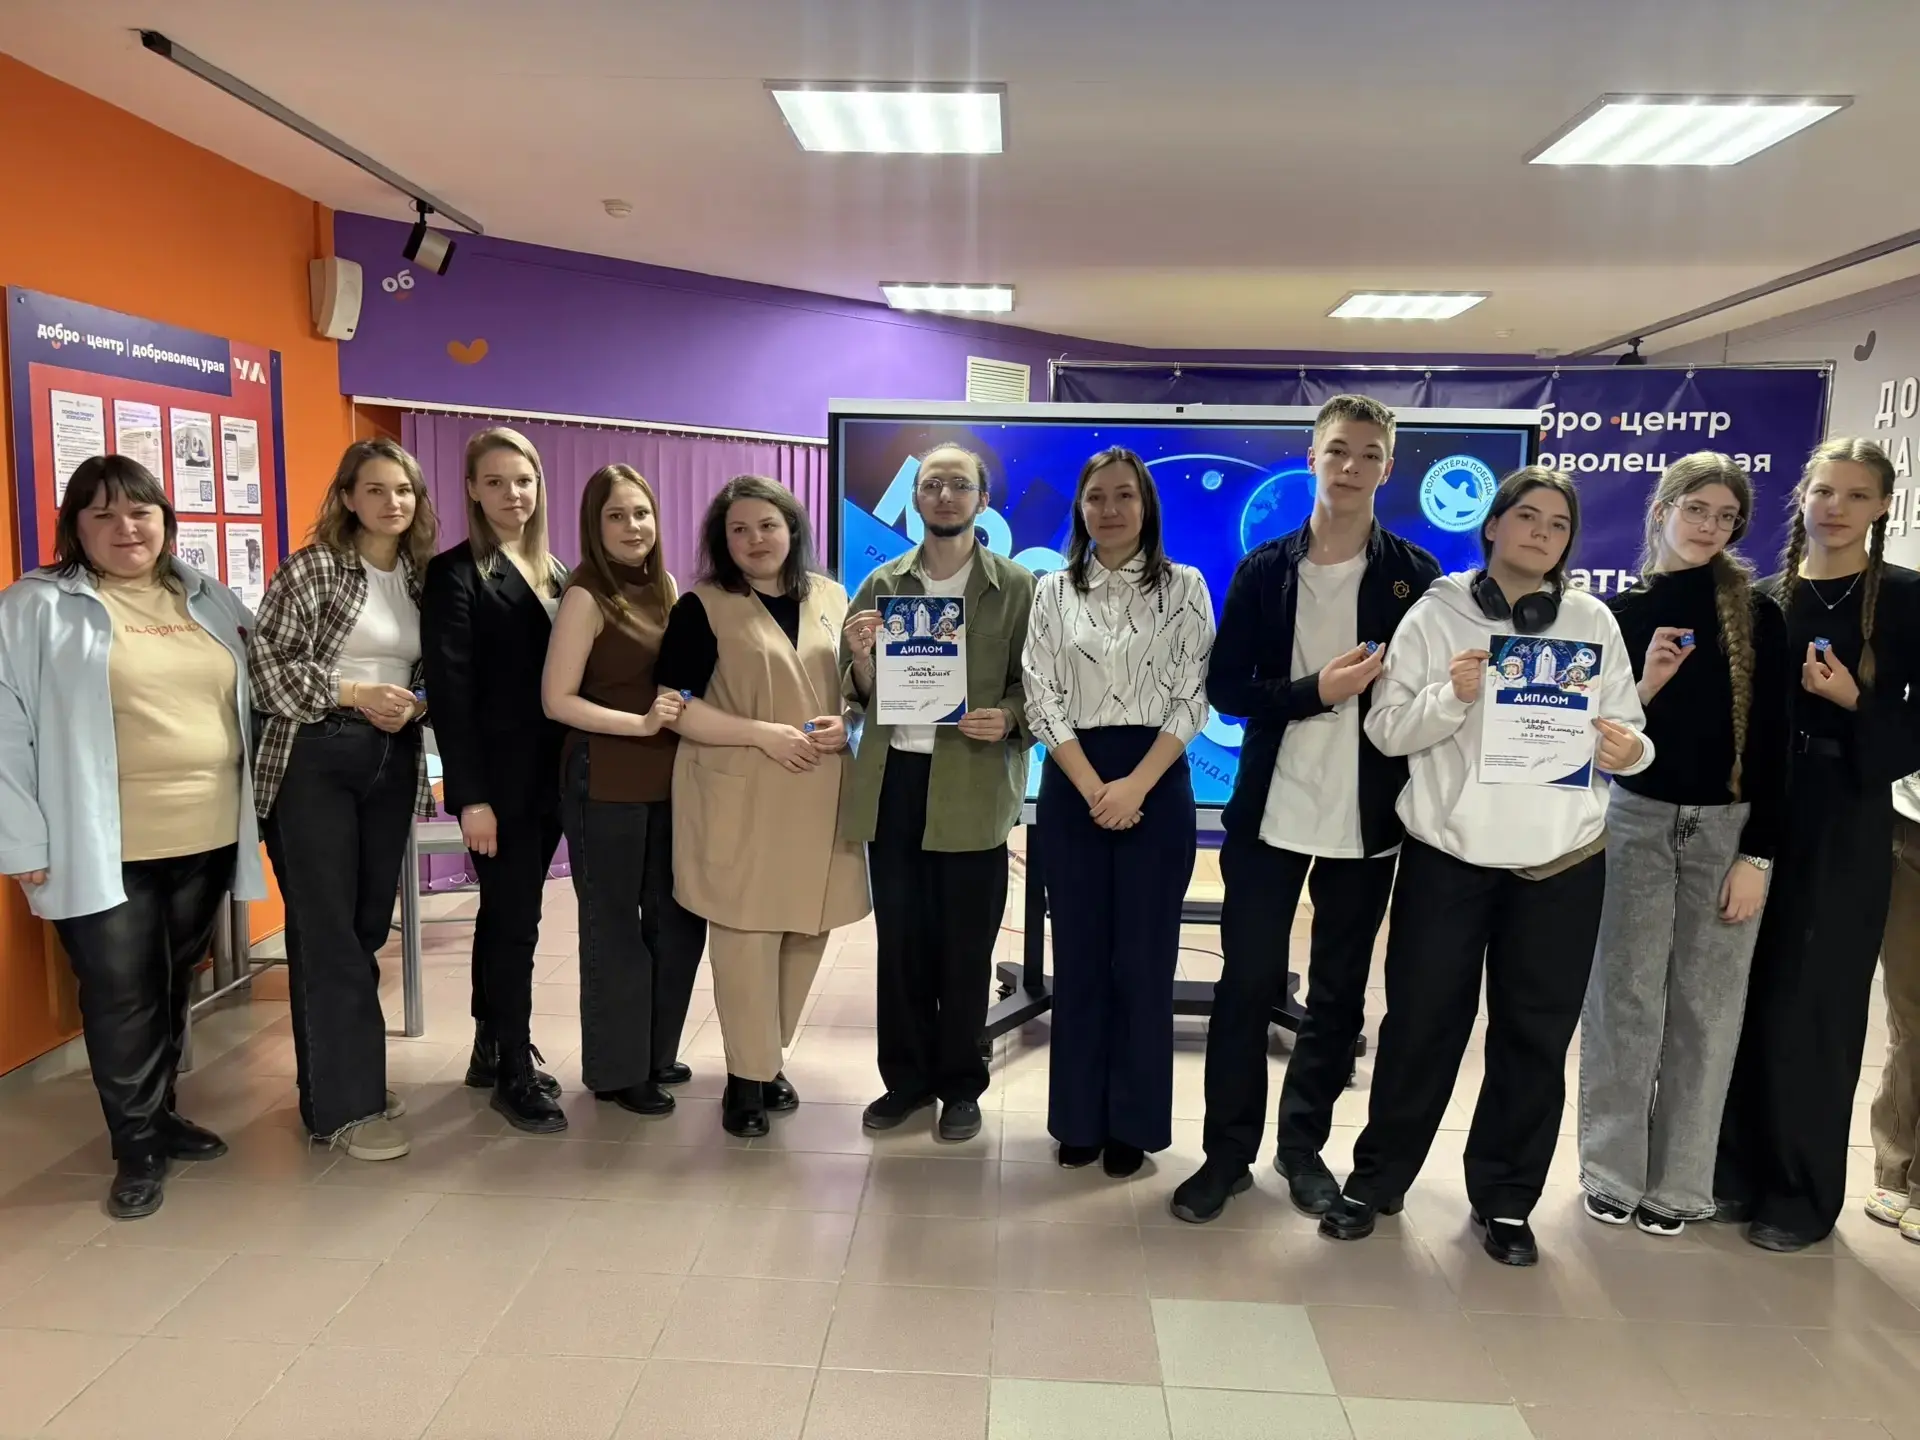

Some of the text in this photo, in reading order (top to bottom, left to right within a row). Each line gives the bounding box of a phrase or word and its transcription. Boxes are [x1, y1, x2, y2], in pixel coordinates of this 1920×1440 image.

[37, 323, 225, 374] добро центр доброволец урая
[1874, 376, 1920, 429] ДО
[1540, 403, 1731, 439] бро центр
[1537, 452, 1668, 473] оволец
[1470, 462, 1493, 496] ПОБЕДЫ
[864, 545, 888, 564] РА
[1568, 568, 1639, 593] ать
[900, 645, 943, 654] ДИПЛОМ
[1513, 692, 1569, 705] ДИПЛОМ
[1187, 751, 1231, 786] АНДА
